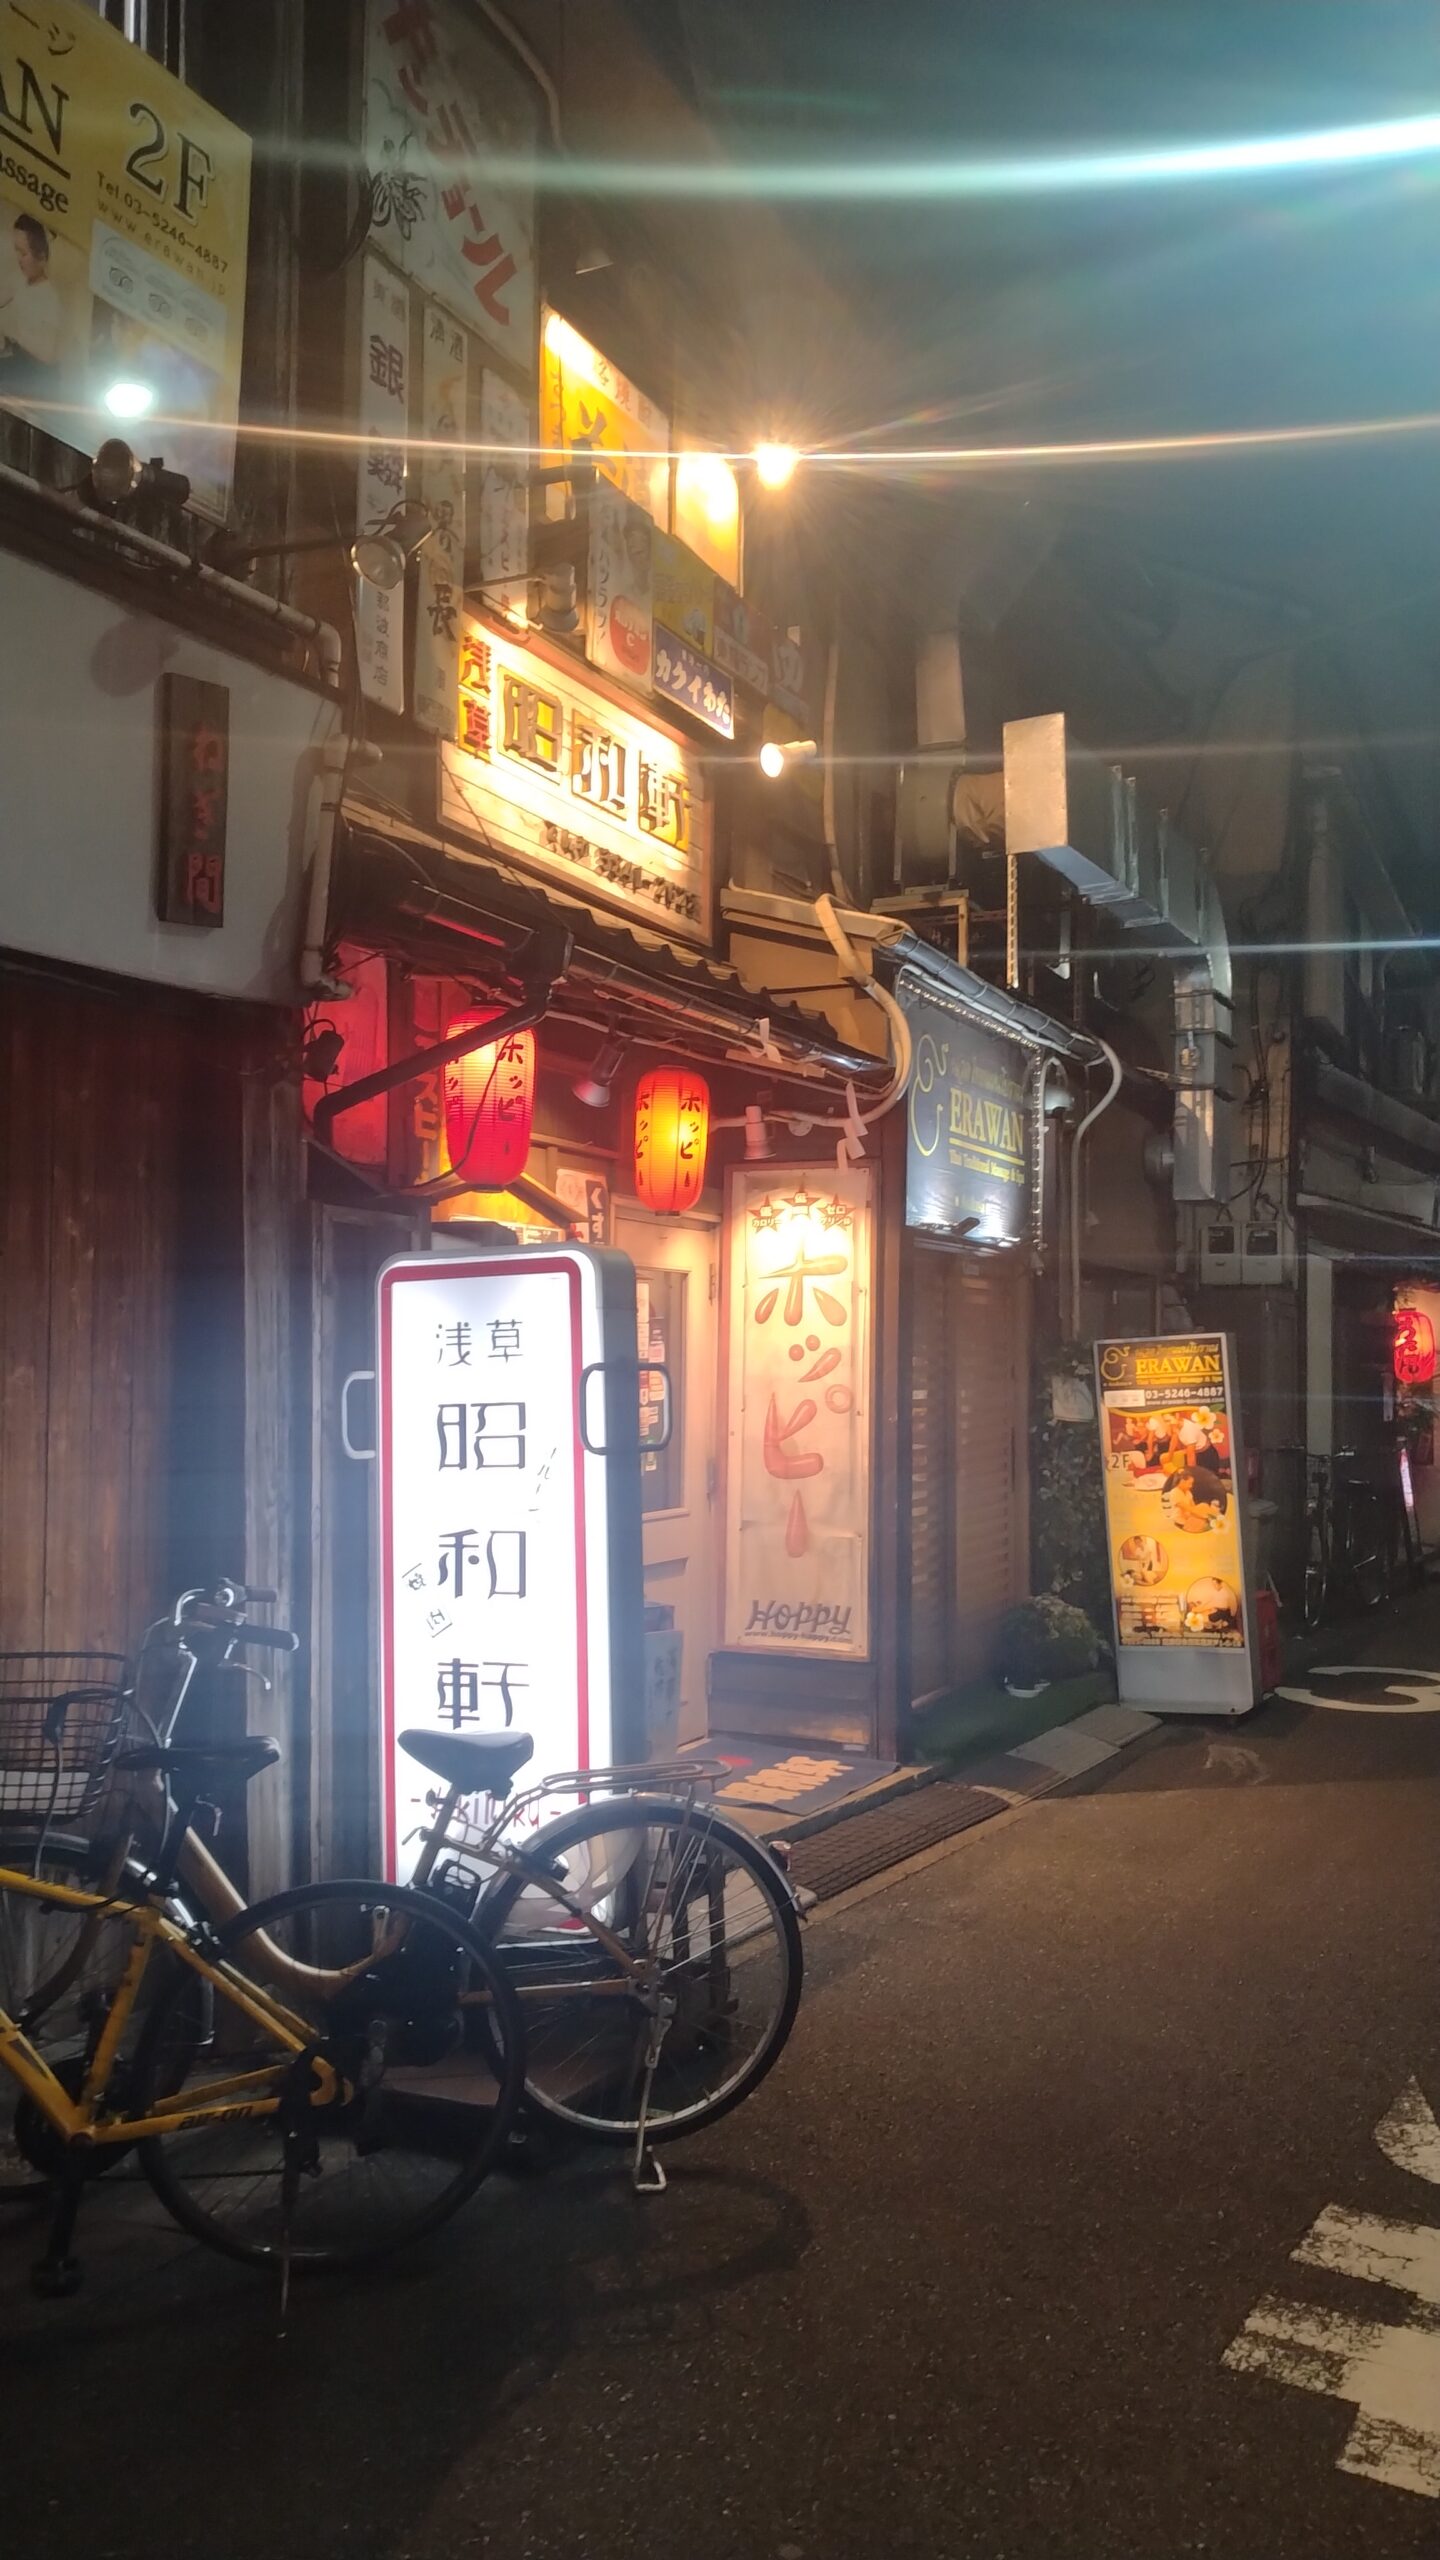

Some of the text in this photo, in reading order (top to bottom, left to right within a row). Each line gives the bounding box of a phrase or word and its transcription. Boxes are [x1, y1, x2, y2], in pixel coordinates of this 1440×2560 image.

[125, 102, 213, 220] 2F
[382, 0, 518, 326] キンチョール
[502, 673, 692, 846] 昭和軒
[680, 1091, 701, 1188] ホッピー
[949, 1086, 1024, 1154] ERAWAN
[590, 1186, 605, 1245] くす
[751, 1217, 782, 1228] カロリー
[826, 1204, 847, 1215] ゼロ
[435, 1319, 524, 1367] 浅草
[1136, 1354, 1221, 1375] ERAWAN
[755, 1222, 855, 1558] ホッピー
[1146, 1387, 1223, 1400] 03-5246-4887
[1111, 1453, 1130, 1470] 2F
[436, 1402, 530, 1730] 昭和軒
[744, 1598, 853, 1635] Hoppy
